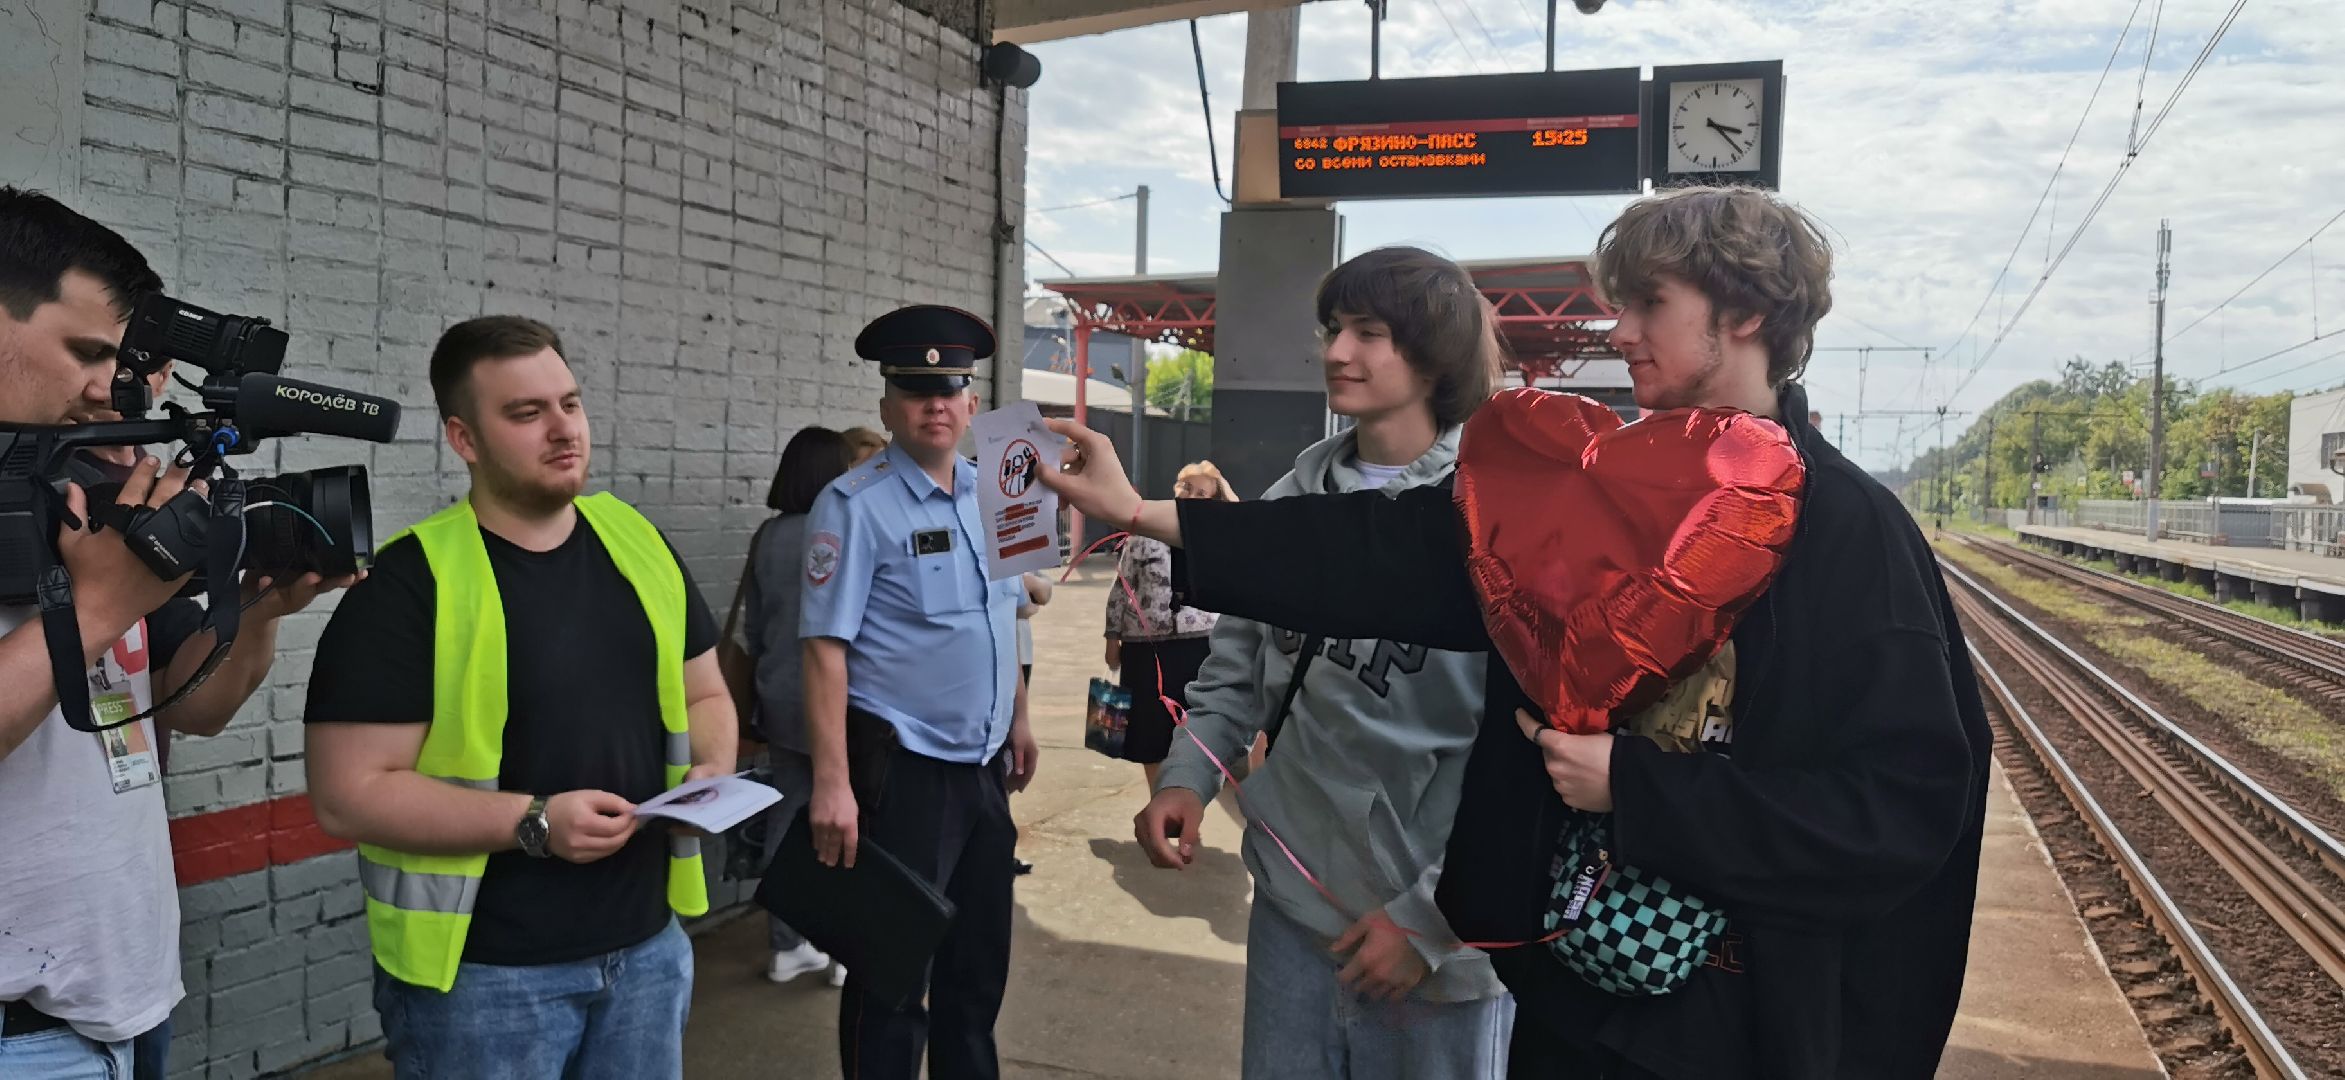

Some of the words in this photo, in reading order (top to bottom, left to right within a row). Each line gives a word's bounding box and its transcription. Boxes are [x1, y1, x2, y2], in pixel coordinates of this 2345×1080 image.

[1532, 129, 1588, 146] 15:25
[1379, 152, 1486, 168] остановками
[275, 384, 357, 411] КОРОЛЁВ
[361, 401, 380, 416] ТВ
[97, 701, 123, 714] PRESS
